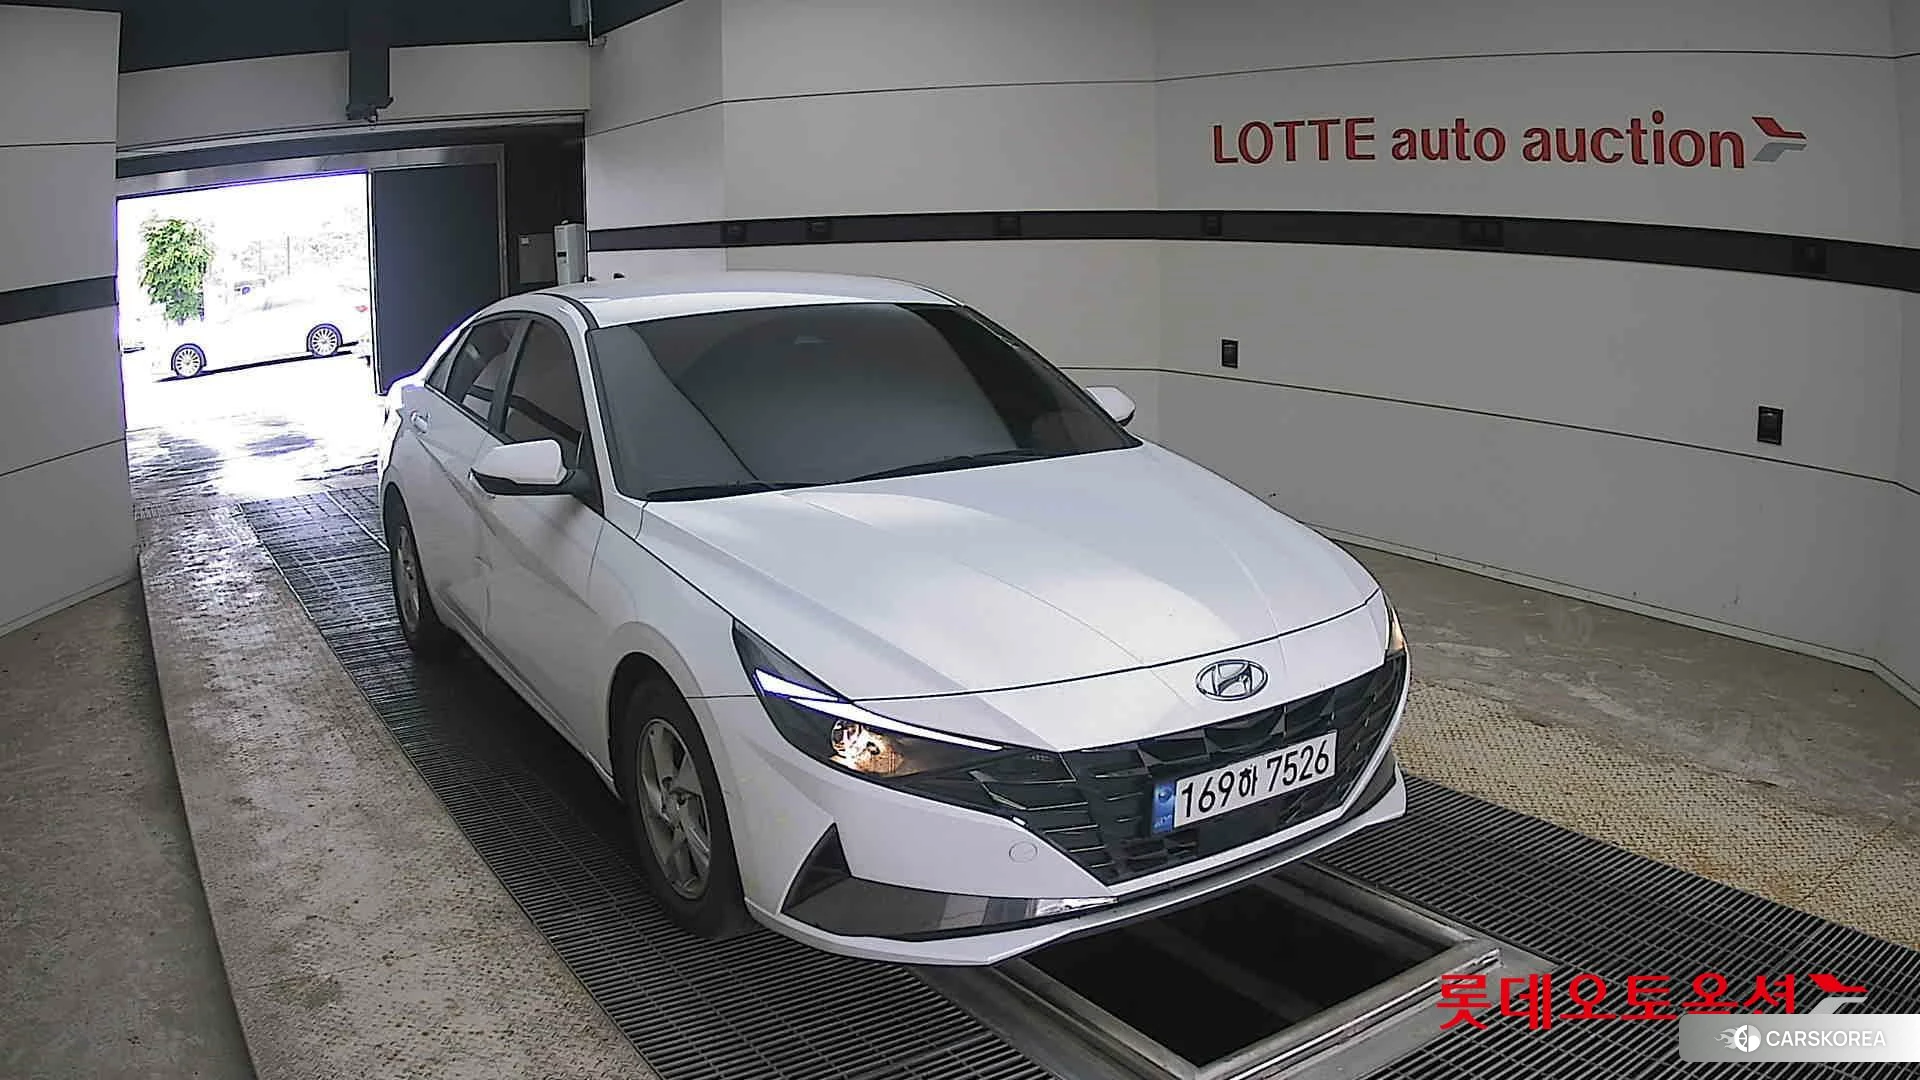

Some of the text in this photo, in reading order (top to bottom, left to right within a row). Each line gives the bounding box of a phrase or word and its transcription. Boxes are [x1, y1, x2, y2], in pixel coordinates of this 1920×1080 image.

[1212, 110, 1746, 169] LOTTE auto auction
[1181, 740, 1330, 818] 169하 7526
